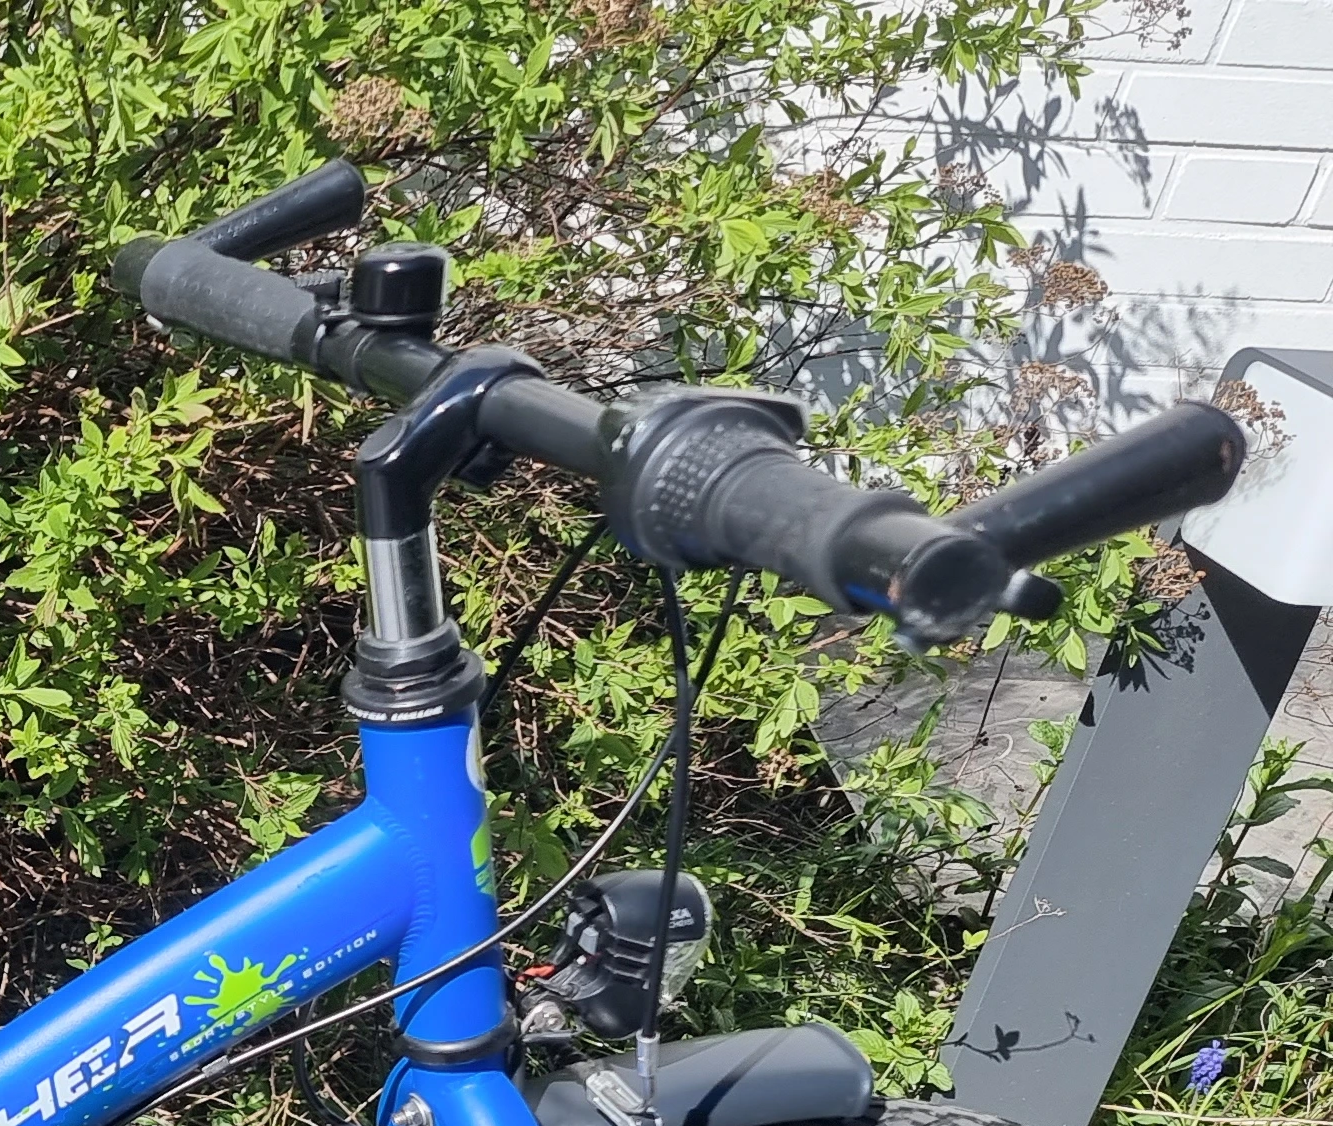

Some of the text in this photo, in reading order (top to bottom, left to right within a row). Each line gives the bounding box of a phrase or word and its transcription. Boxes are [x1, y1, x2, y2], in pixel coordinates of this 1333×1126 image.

[169, 929, 377, 1062] SPORT STYLE EDITION
